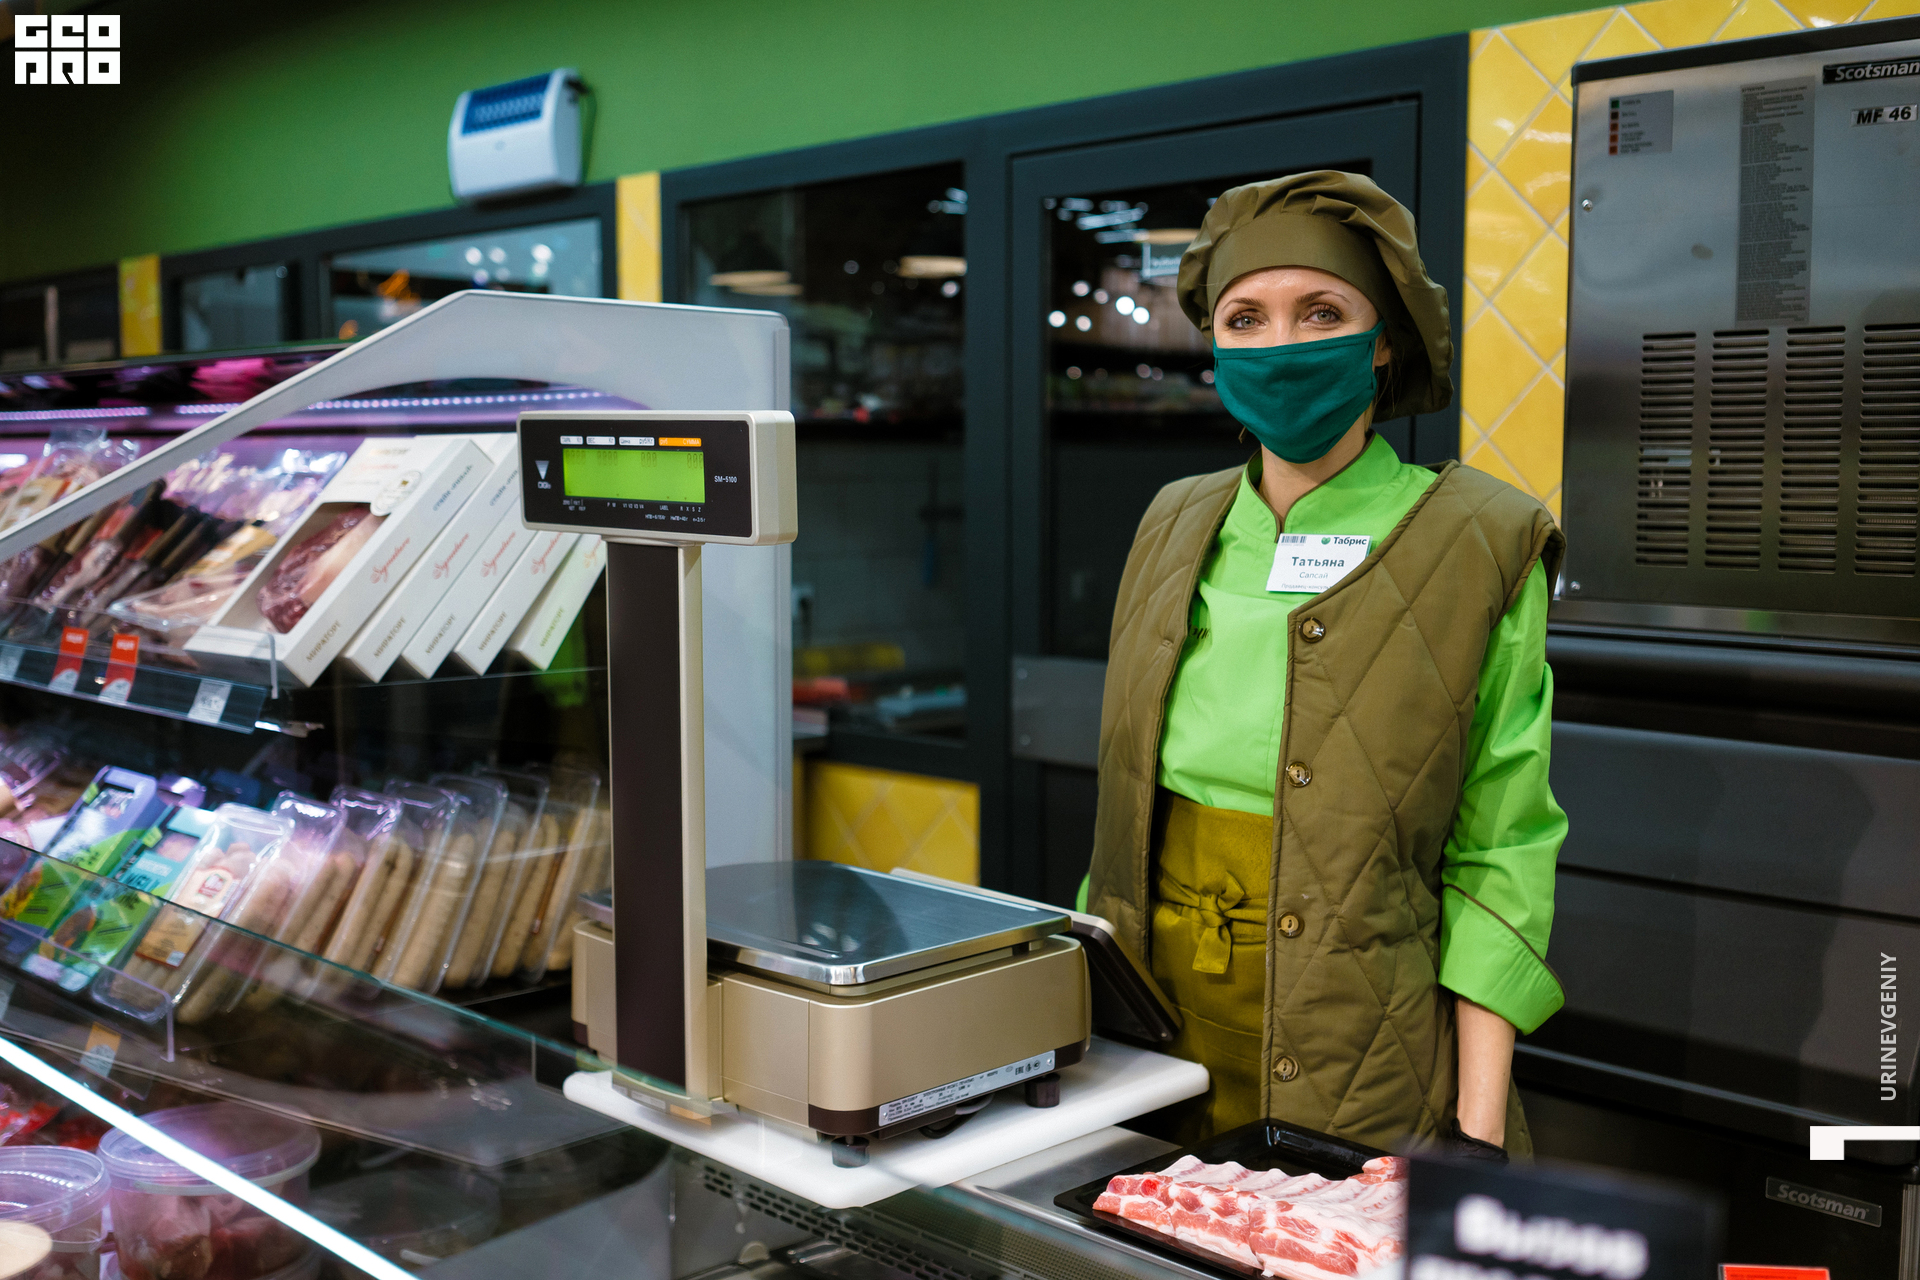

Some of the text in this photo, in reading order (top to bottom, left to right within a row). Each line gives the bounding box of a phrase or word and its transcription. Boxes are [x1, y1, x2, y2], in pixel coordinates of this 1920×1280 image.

[1835, 61, 1920, 81] Scotsman
[1857, 106, 1912, 125] MF 46
[683, 438, 700, 446] СУММА
[714, 475, 738, 483] SM-5100
[1333, 536, 1367, 546] Табрис
[1291, 556, 1345, 567] Татьяна
[1777, 1184, 1867, 1220] Scotsman
